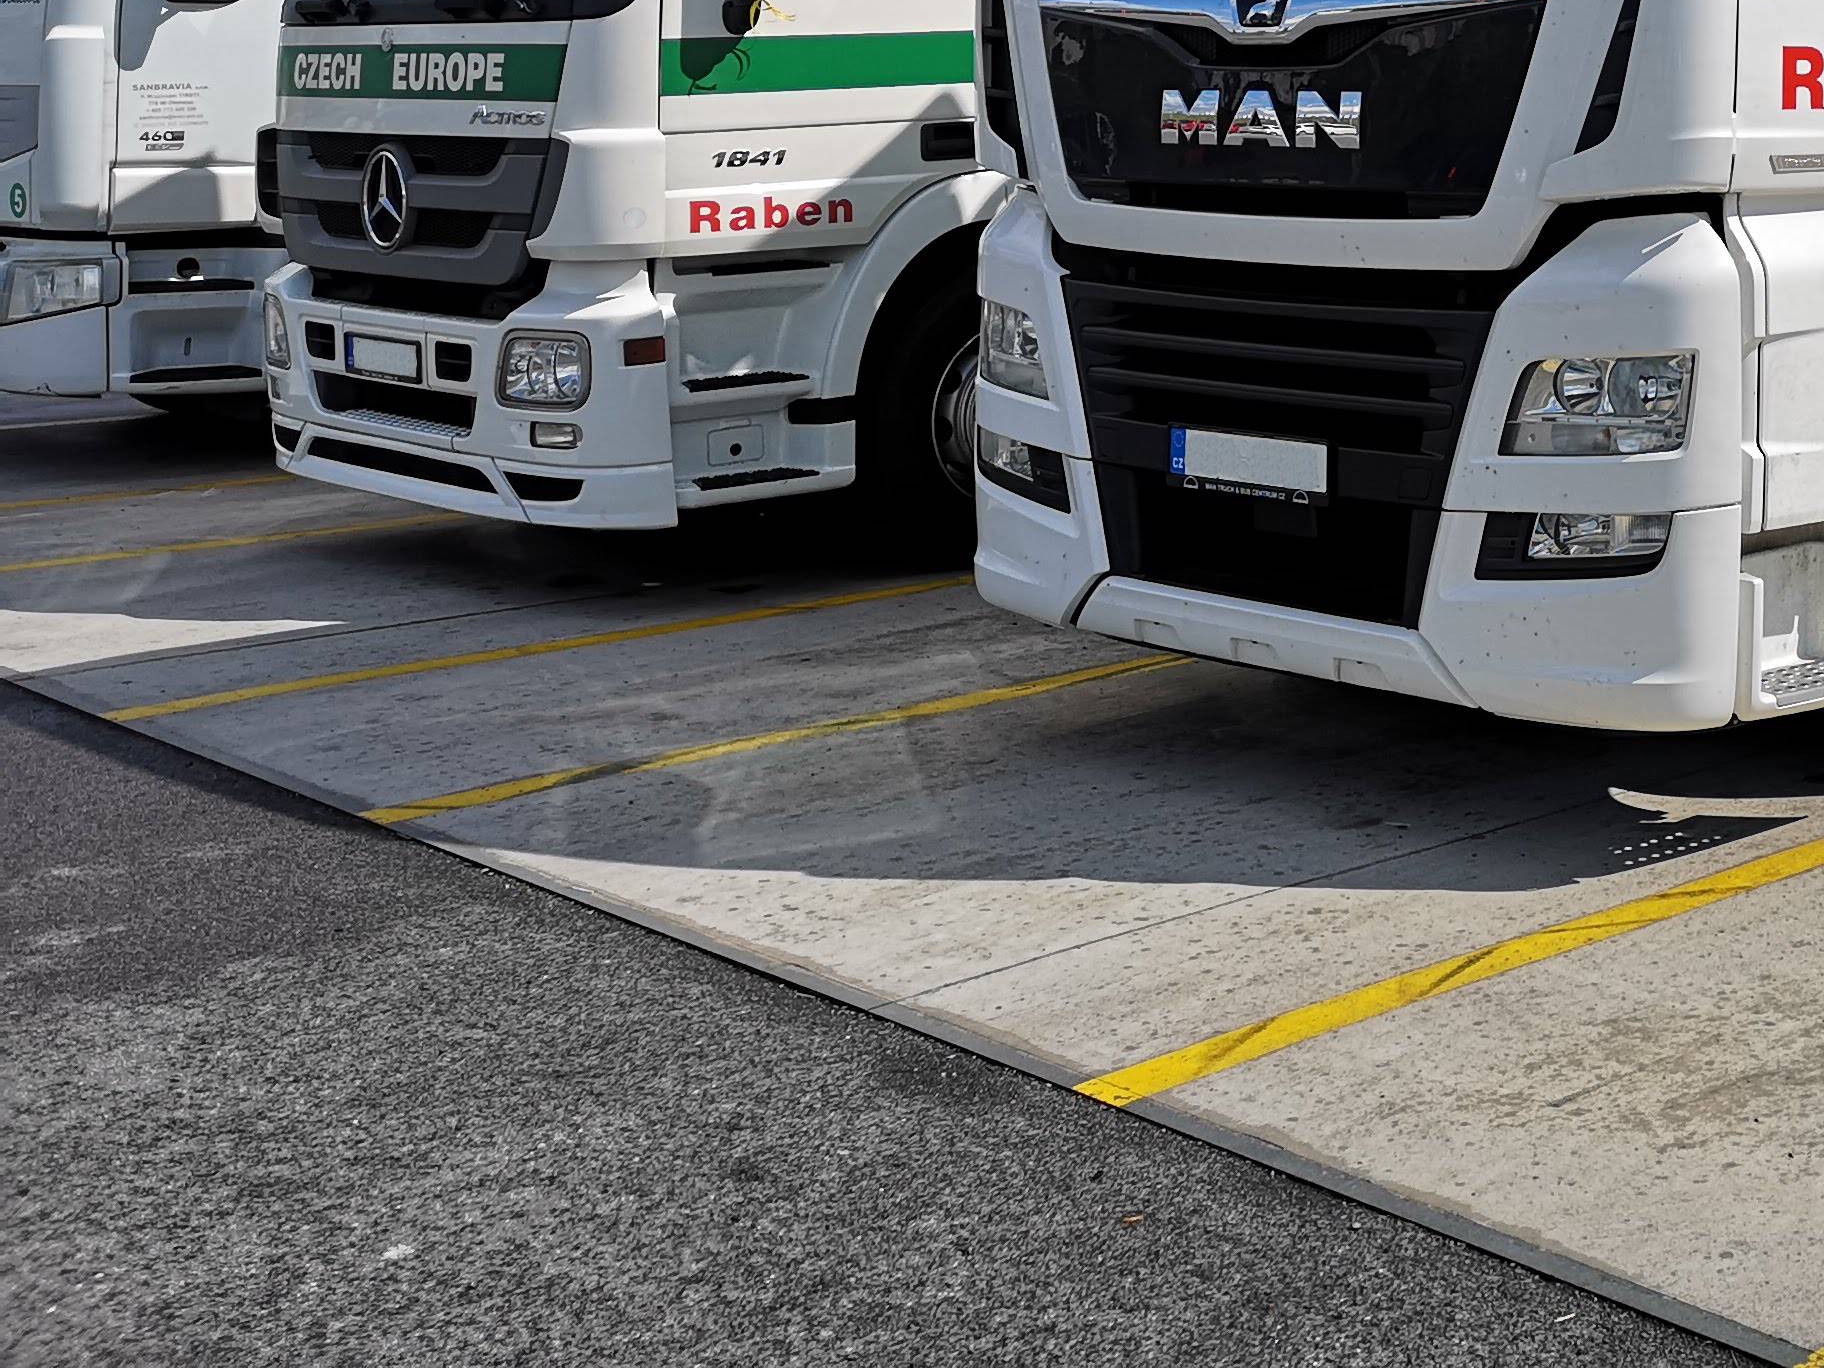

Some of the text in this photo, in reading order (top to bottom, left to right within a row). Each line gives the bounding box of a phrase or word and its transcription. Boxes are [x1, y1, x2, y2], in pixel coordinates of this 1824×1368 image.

[293, 51, 505, 92] CZECH EUROPE
[1160, 88, 1363, 150] MAN
[139, 130, 175, 142] 460
[711, 148, 788, 168] 1841
[14, 188, 23, 213] 5
[689, 195, 854, 234] Raben
[1172, 456, 1185, 469] CZ
